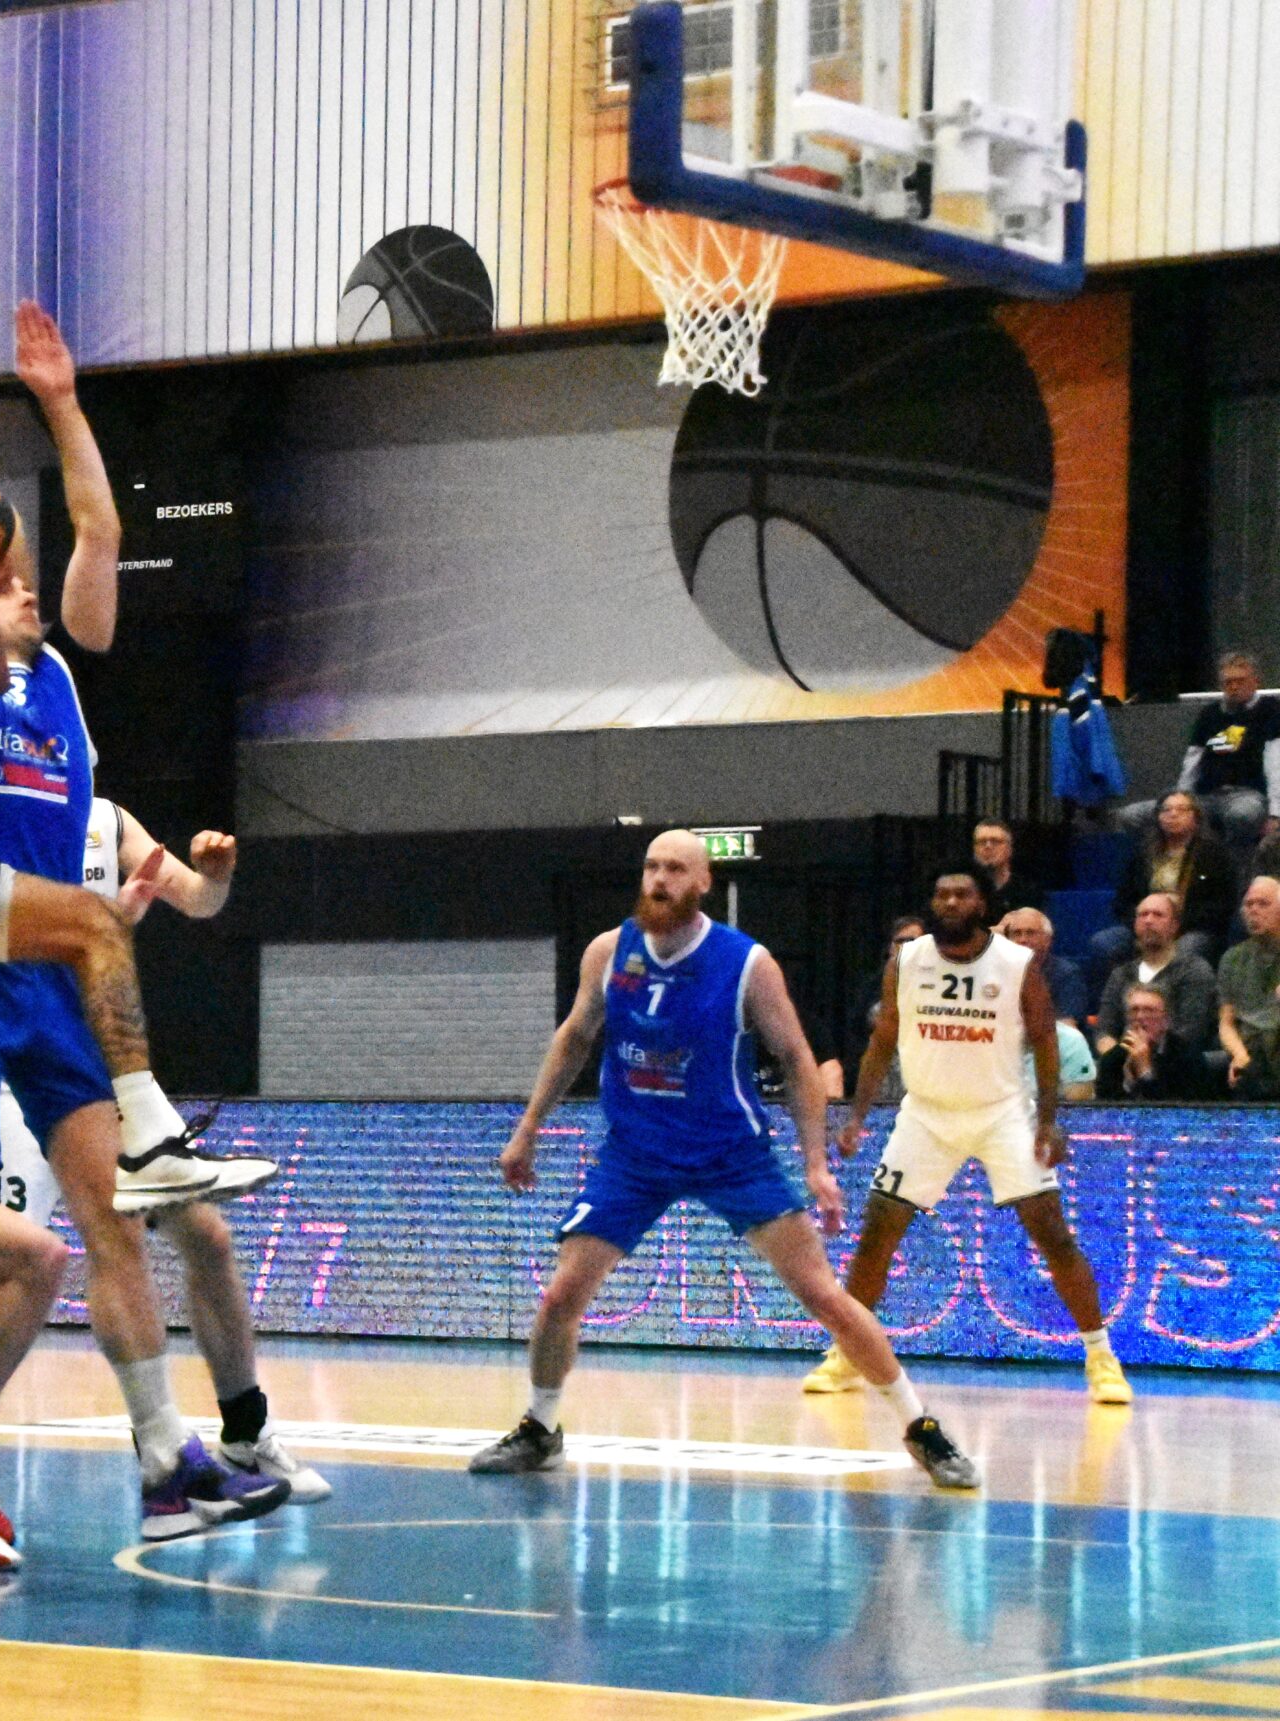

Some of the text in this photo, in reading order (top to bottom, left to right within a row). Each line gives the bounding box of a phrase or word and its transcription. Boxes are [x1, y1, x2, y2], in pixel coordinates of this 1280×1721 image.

[156, 501, 233, 519] BEZOEKERS
[647, 982, 666, 1017] 1
[940, 972, 974, 1001] 21
[916, 1004, 997, 1021] LEEUWARDEN
[871, 1162, 905, 1196] 21
[560, 1202, 594, 1233] 1
